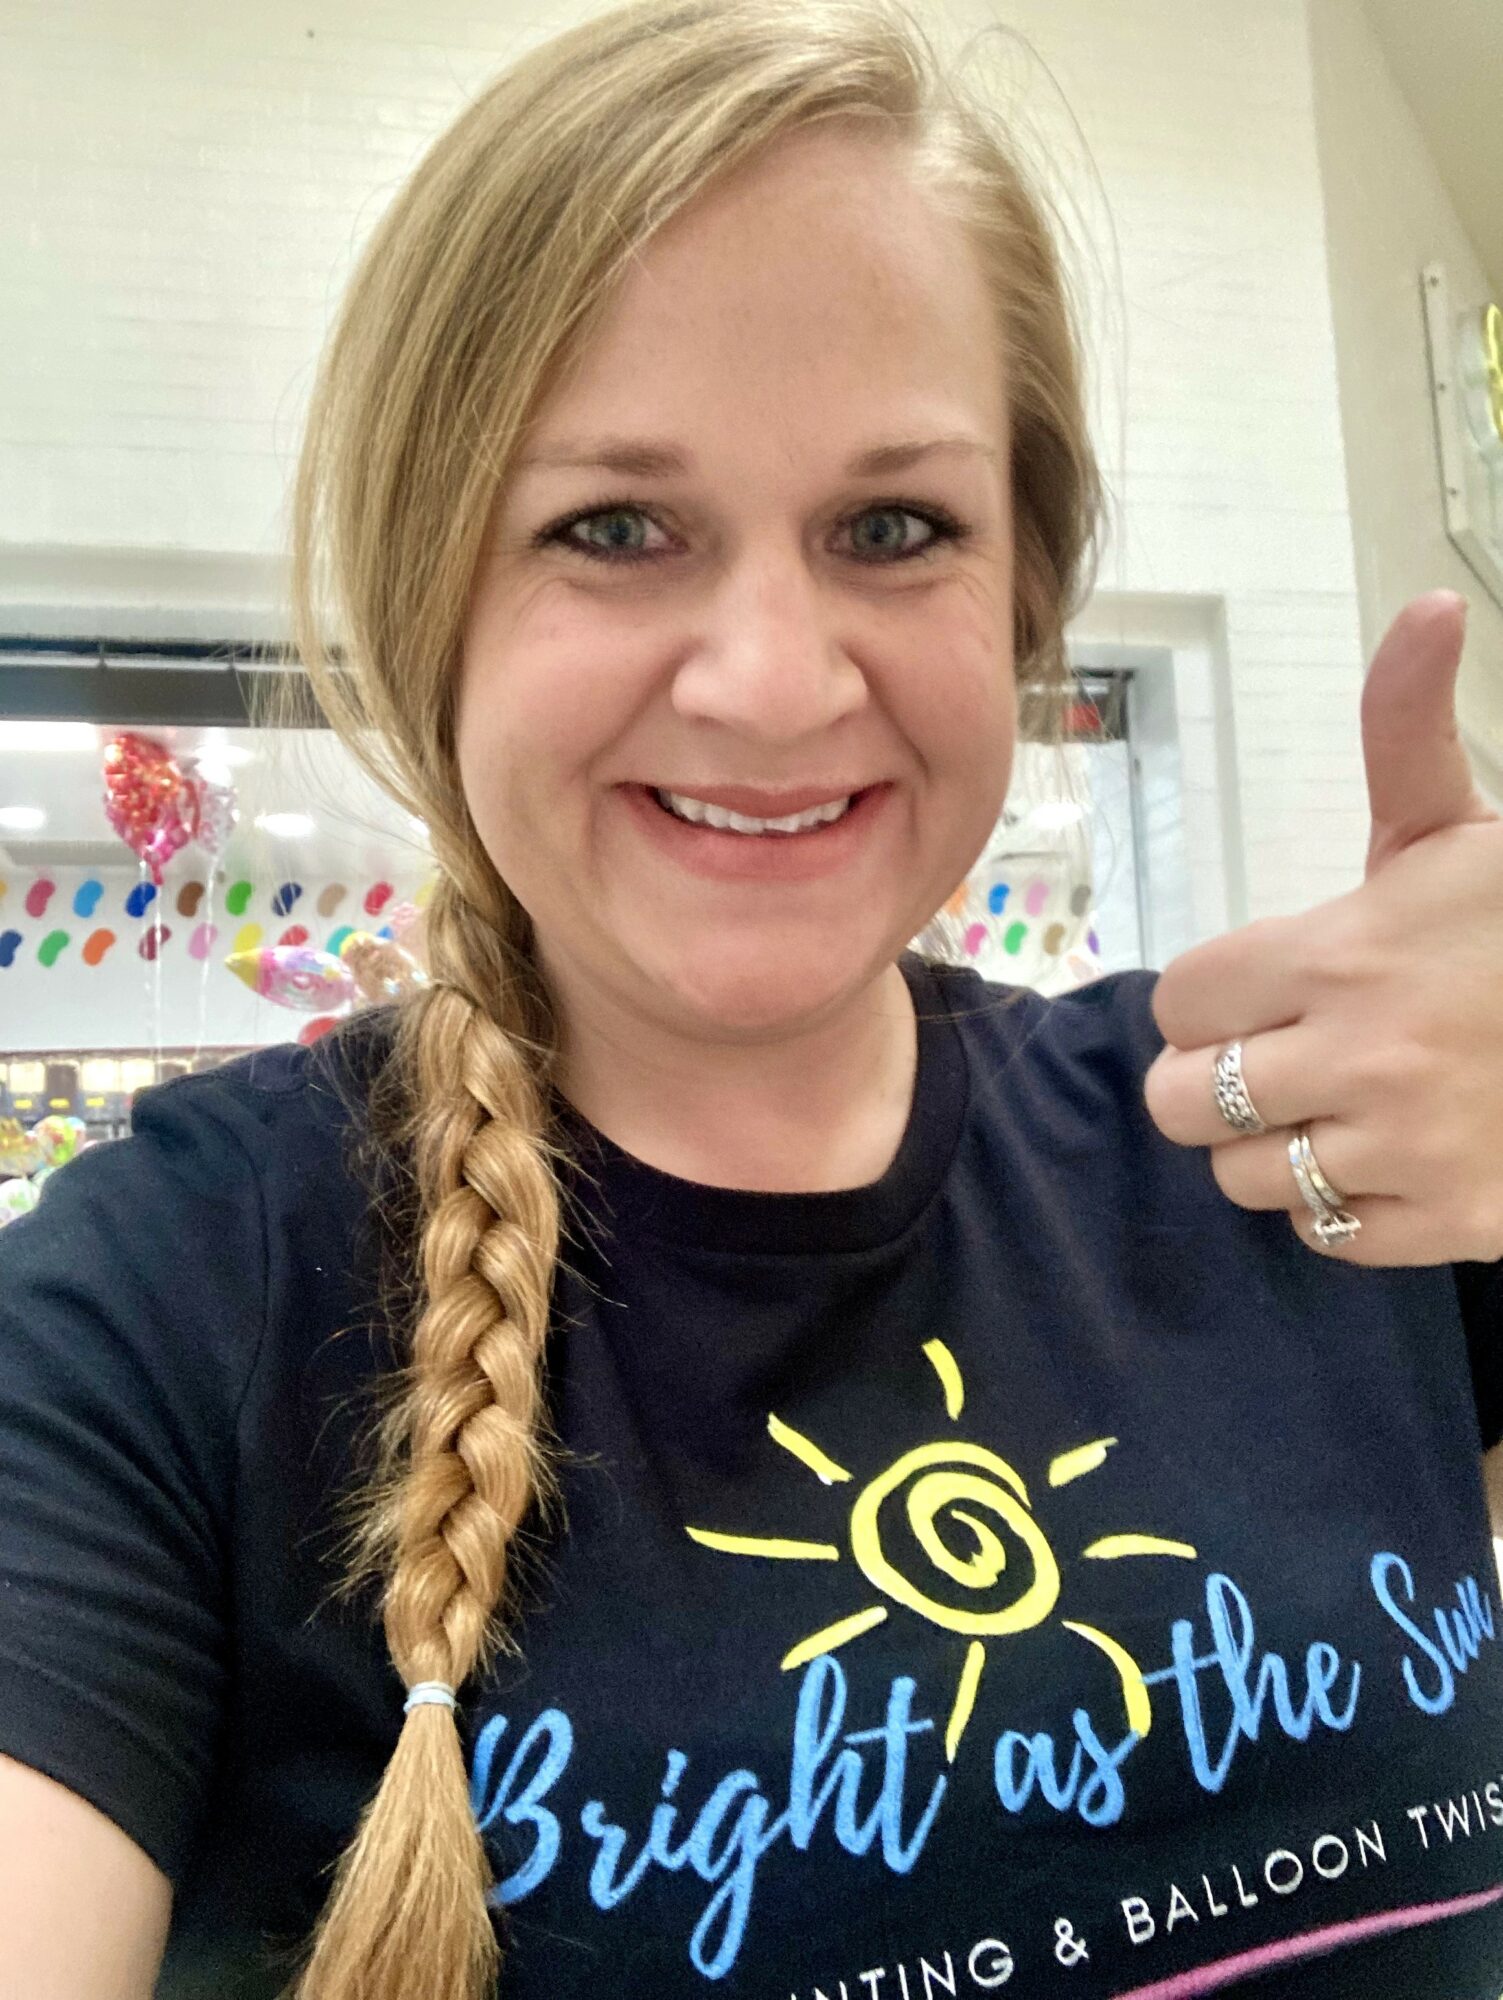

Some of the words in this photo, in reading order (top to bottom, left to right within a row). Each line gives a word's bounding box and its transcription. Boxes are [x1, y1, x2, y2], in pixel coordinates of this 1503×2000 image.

[473, 1654, 947, 1980] Bright
[995, 1708, 1141, 1827] as
[1140, 1572, 1360, 1793] the
[1371, 1551, 1495, 1715] Sun
[1054, 1916, 1089, 1967] &
[1120, 1820, 1387, 1945] BALLOON
[1406, 1773, 1503, 1850] TWIS
